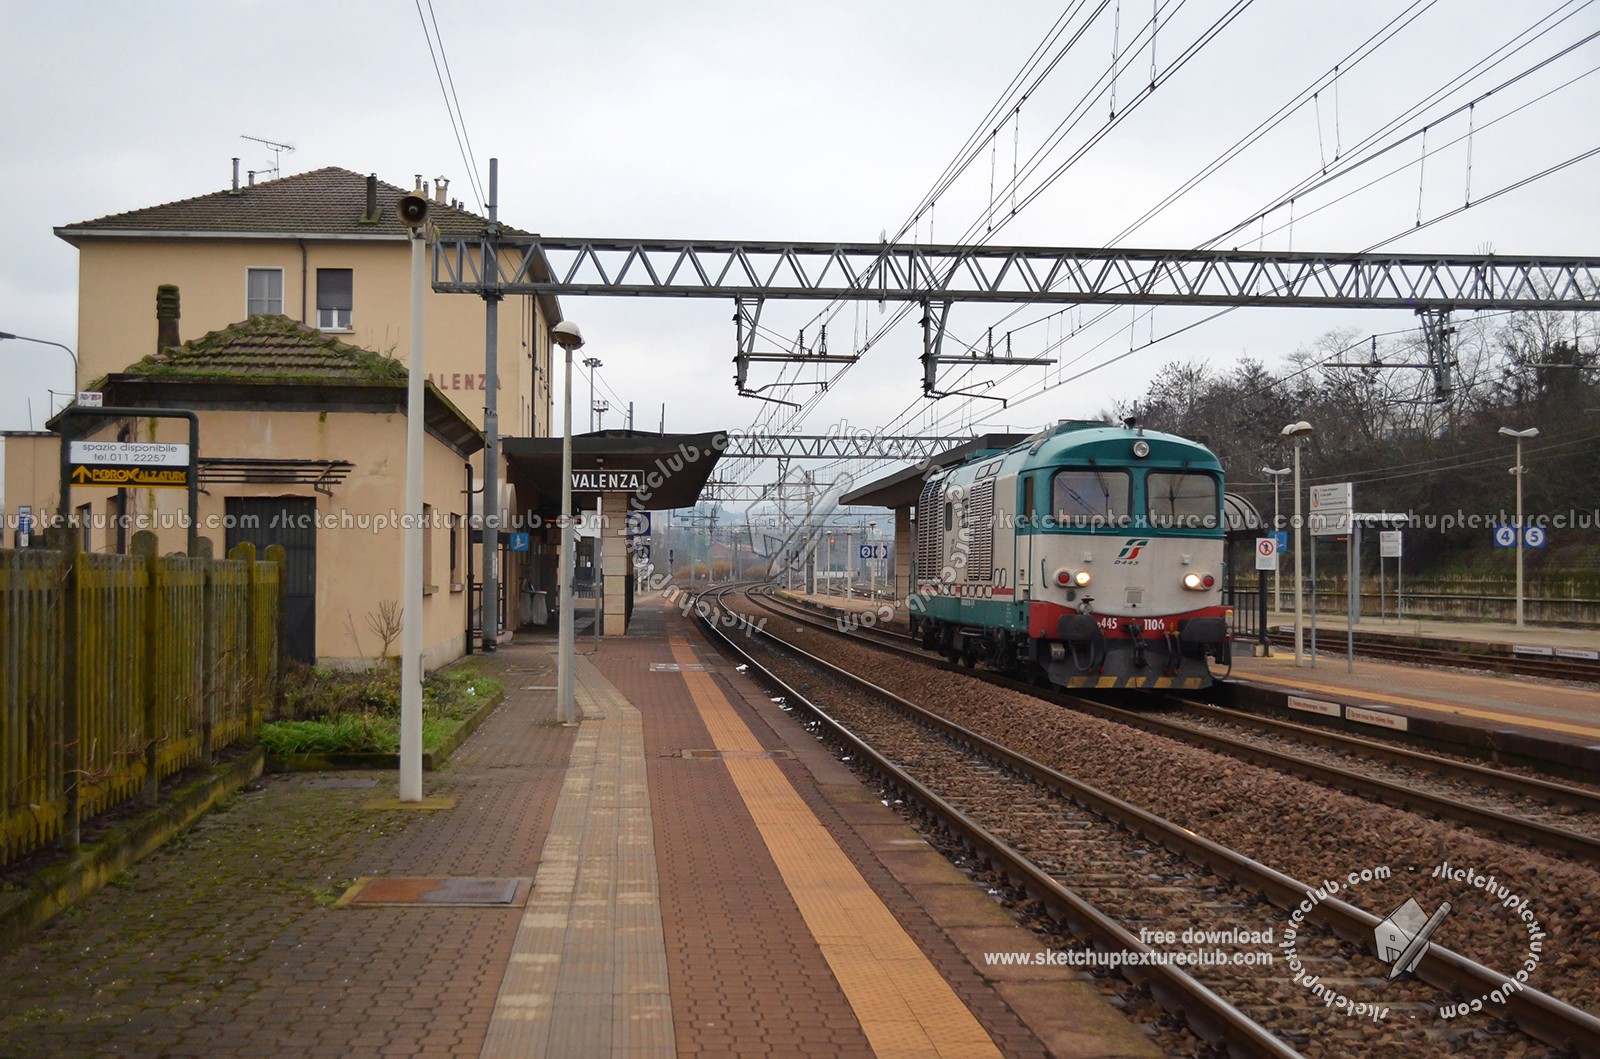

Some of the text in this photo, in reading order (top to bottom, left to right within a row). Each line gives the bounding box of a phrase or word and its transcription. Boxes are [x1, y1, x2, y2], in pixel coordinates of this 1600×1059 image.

[82, 443, 178, 454] spazio disponibile
[94, 453, 167, 463] tel.011.22257
[571, 473, 639, 488] VALENZA
[1143, 618, 1166, 631] 1106
